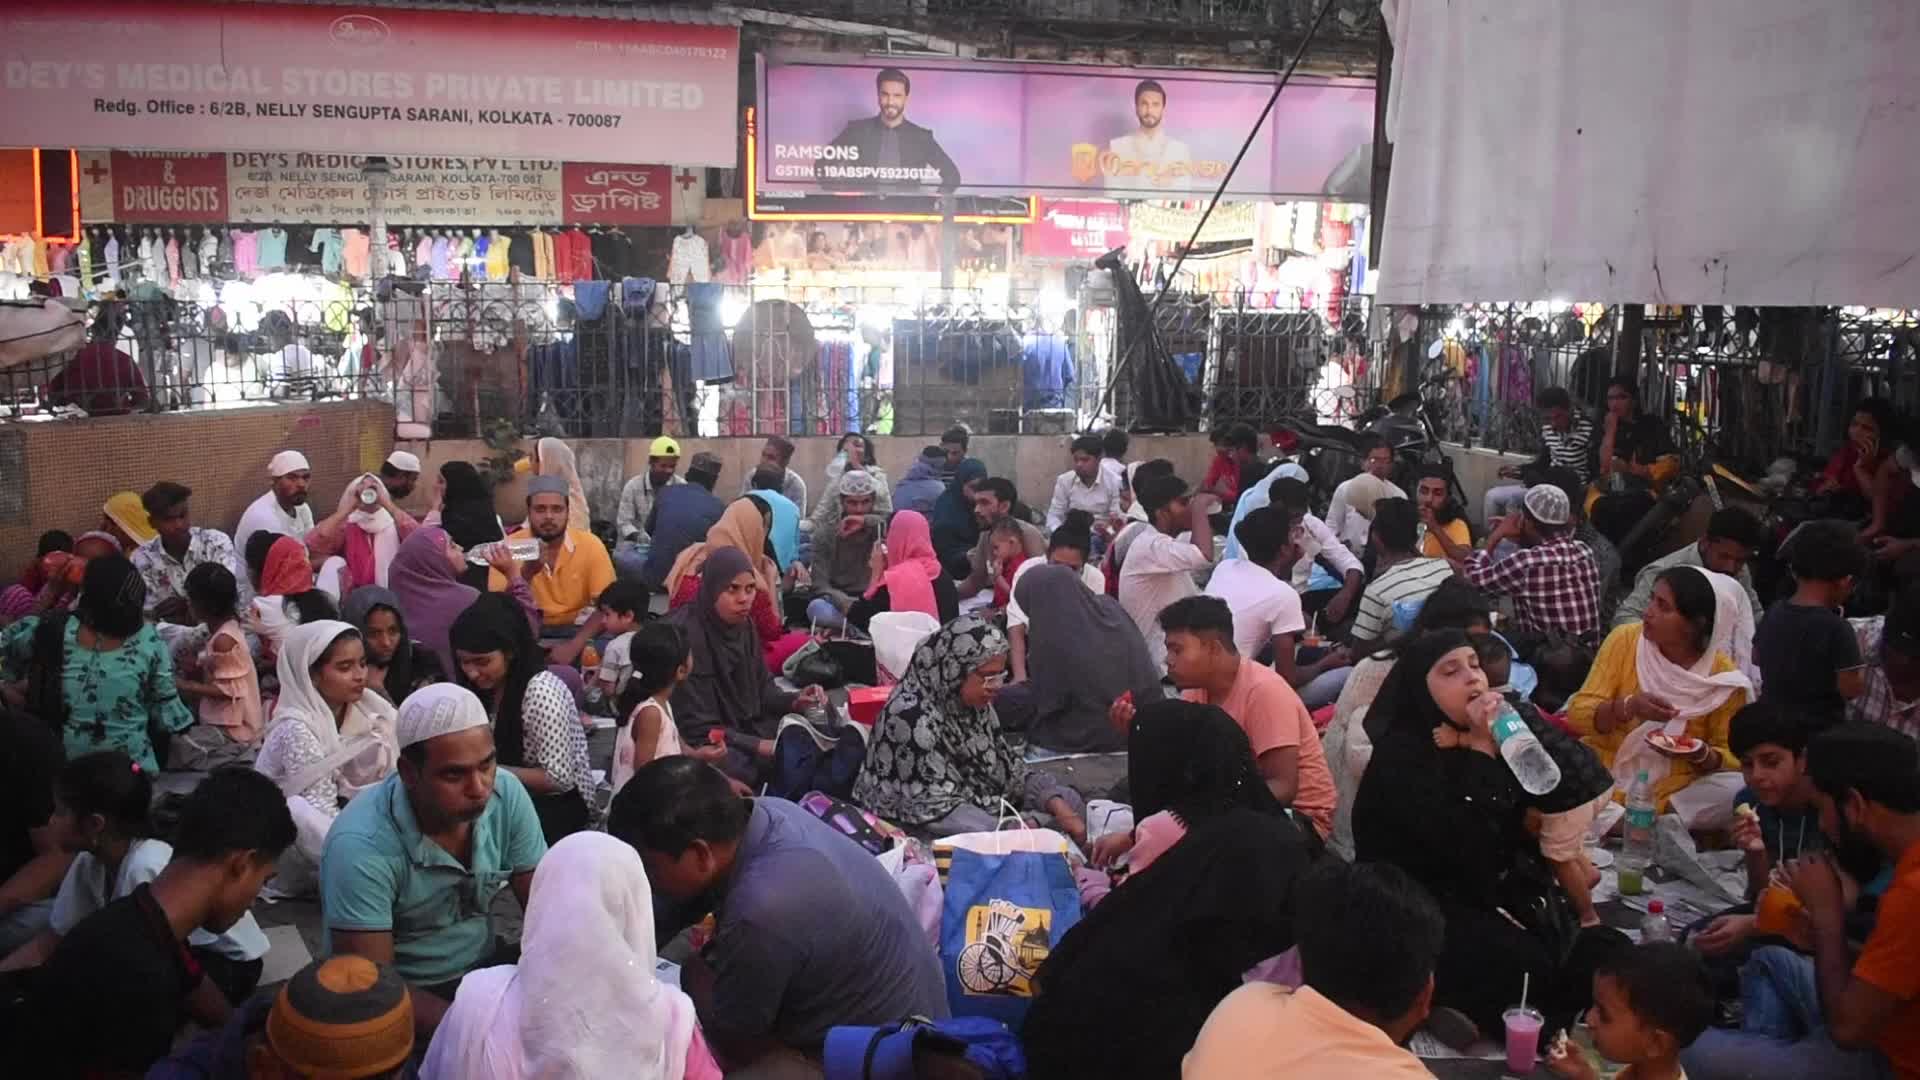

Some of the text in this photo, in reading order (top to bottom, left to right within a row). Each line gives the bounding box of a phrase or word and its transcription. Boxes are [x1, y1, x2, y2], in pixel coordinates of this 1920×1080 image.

[6, 61, 705, 111] DEY'S MEDICAL STORES PRIVATE LIMITED
[94, 98, 142, 116] Redg.
[146, 99, 196, 115] Office
[200, 103, 206, 115] :
[210, 101, 251, 118] 6/2B,
[256, 102, 308, 118] NELLY
[312, 104, 402, 122] SENGUPTA
[407, 107, 474, 125] SARANI,
[478, 110, 553, 126] KOLKATA
[567, 113, 622, 128] 700087
[774, 145, 860, 161] RAMSONS
[163, 161, 176, 185] &
[584, 169, 651, 187] এন্ড
[775, 165, 815, 177] GSTIN
[122, 185, 219, 211] DRUGGISTS
